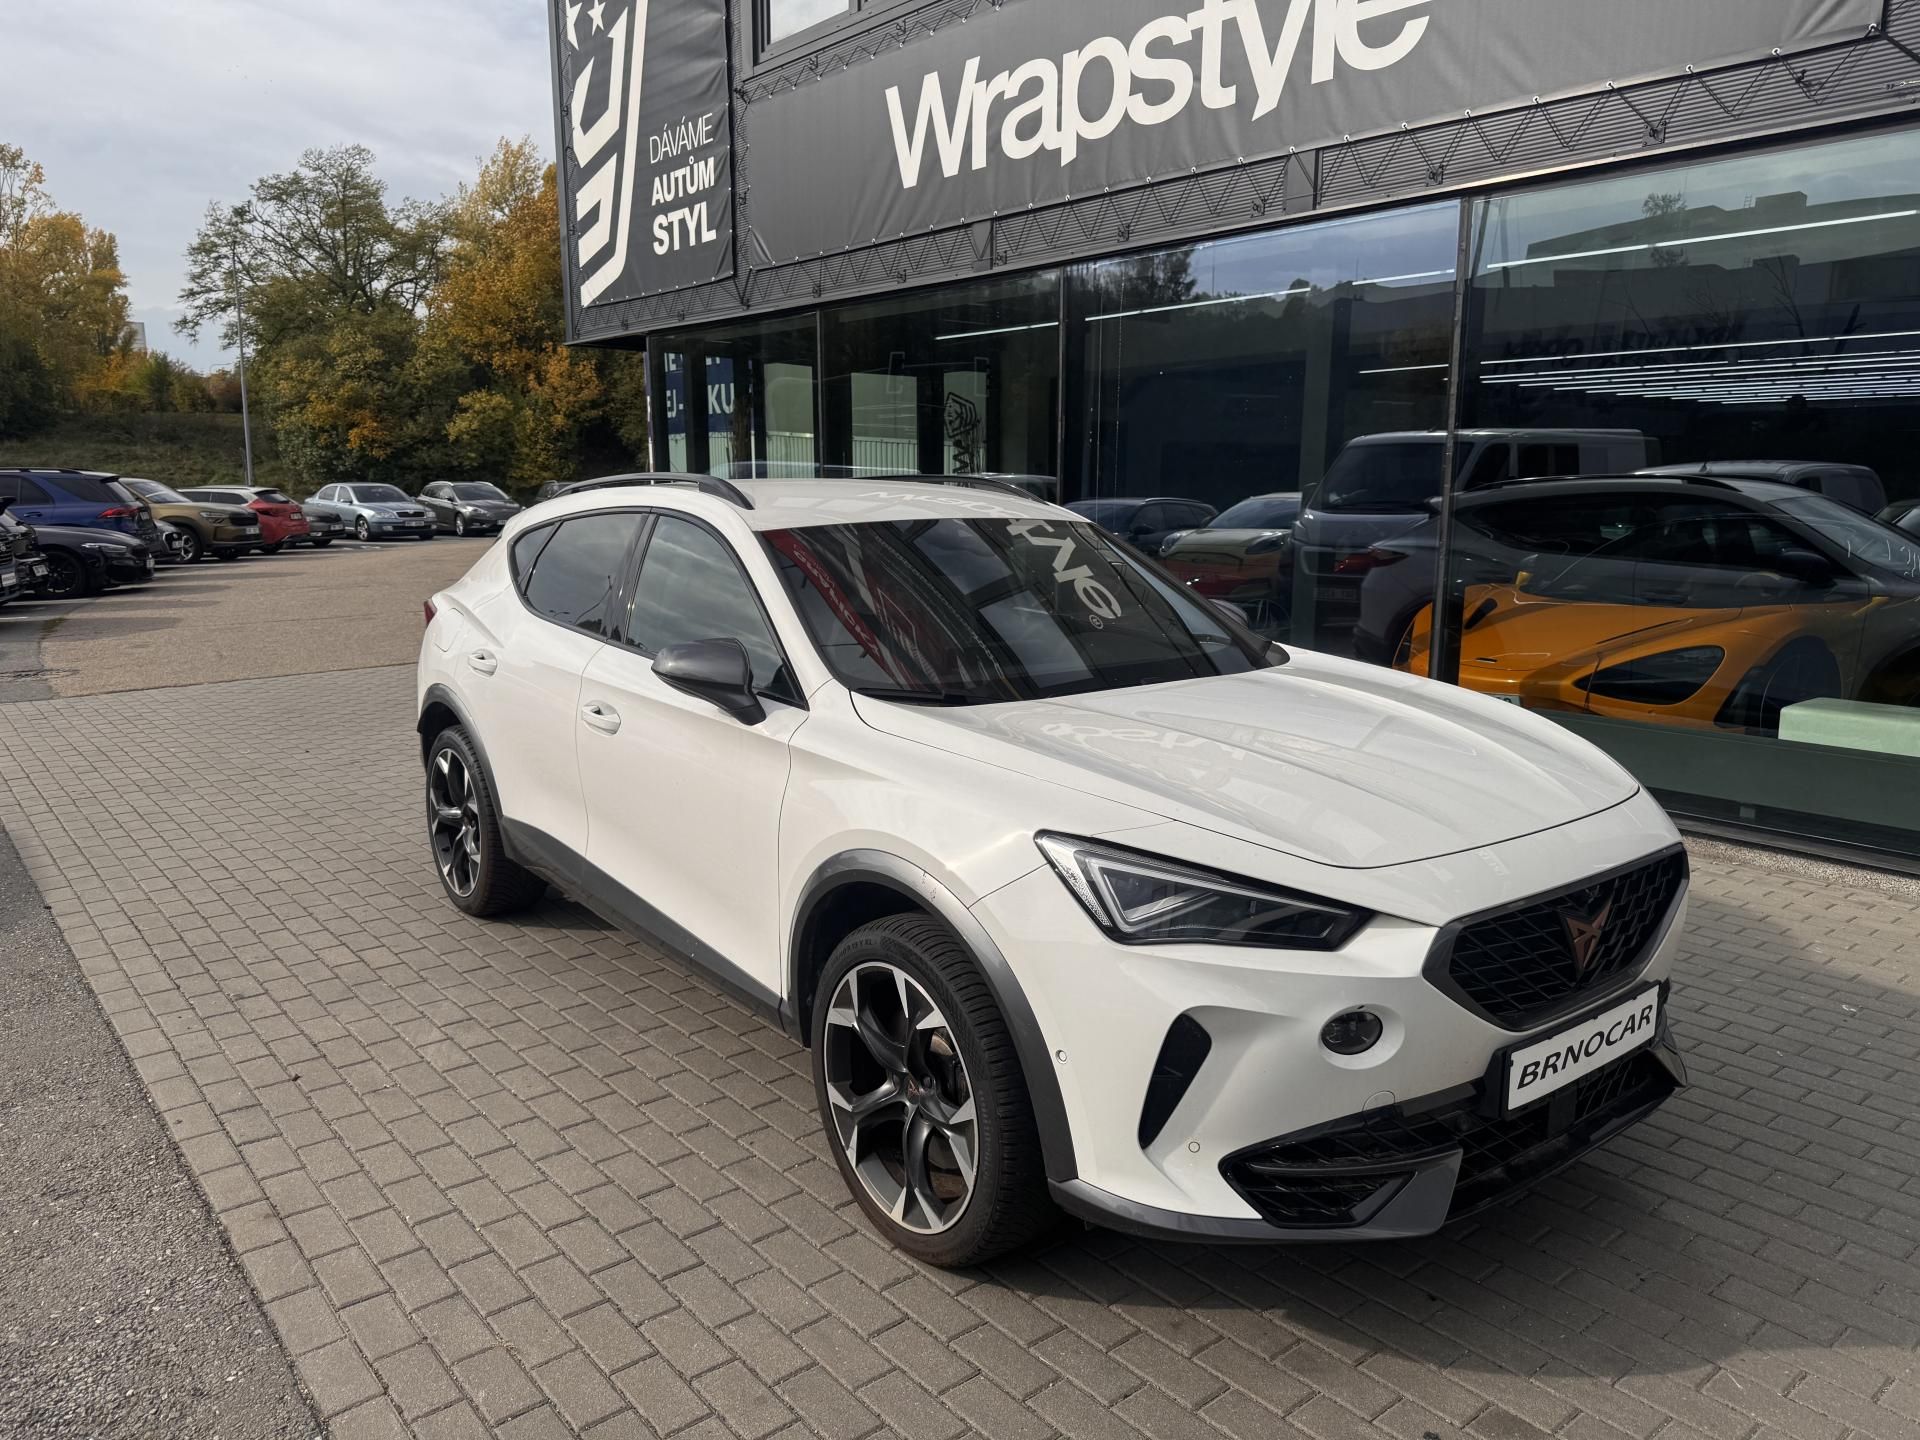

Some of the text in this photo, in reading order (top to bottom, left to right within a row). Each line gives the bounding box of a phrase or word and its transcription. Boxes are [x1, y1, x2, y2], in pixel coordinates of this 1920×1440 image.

[885, 0, 1430, 189] Wrapstyle
[650, 112, 714, 164] DÁVÁME
[651, 155, 715, 206] AUTŮM
[652, 201, 717, 256] STYL
[1516, 1004, 1653, 1089] BRNOCAR
